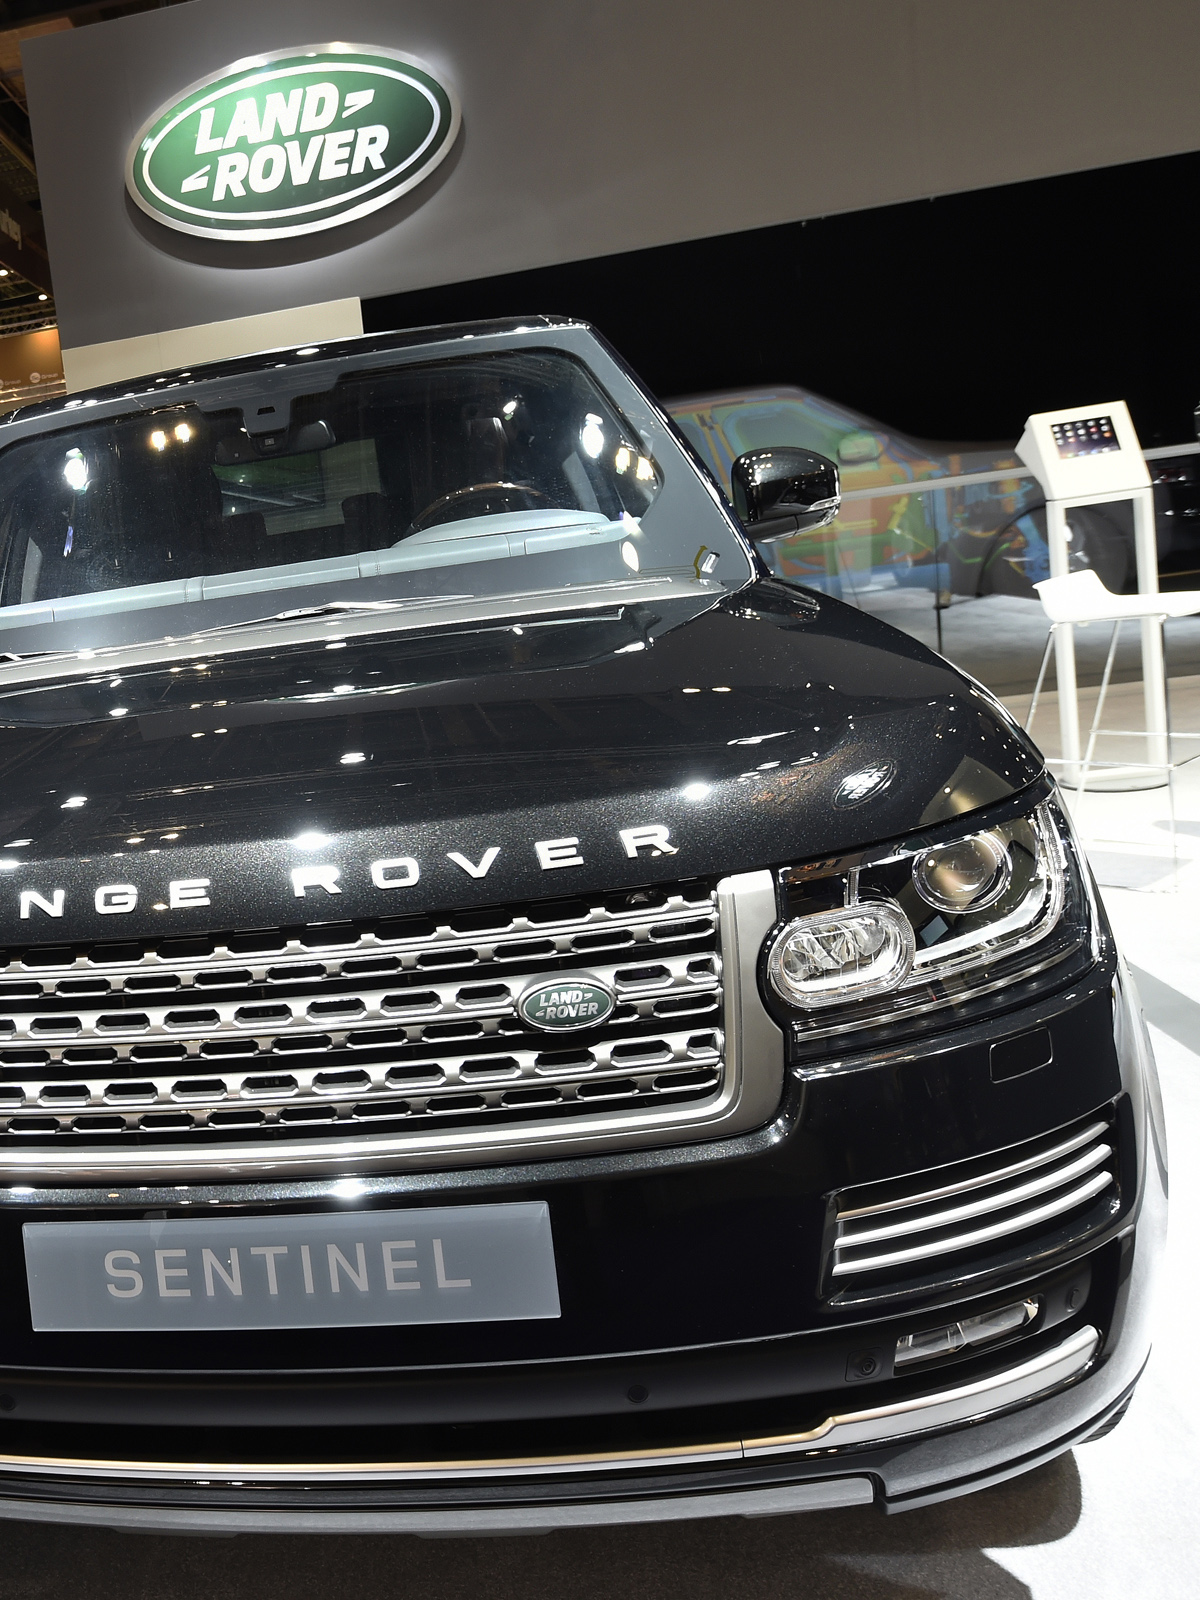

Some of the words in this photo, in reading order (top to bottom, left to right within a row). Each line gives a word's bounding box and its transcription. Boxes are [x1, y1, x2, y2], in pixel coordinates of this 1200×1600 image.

[195, 82, 339, 155] LAND
[212, 124, 390, 202] ROVER
[290, 823, 679, 898] ROVER
[539, 990, 583, 1007] LAND
[545, 1002, 599, 1020] ROVER
[103, 1238, 472, 1299] SENTINEL
